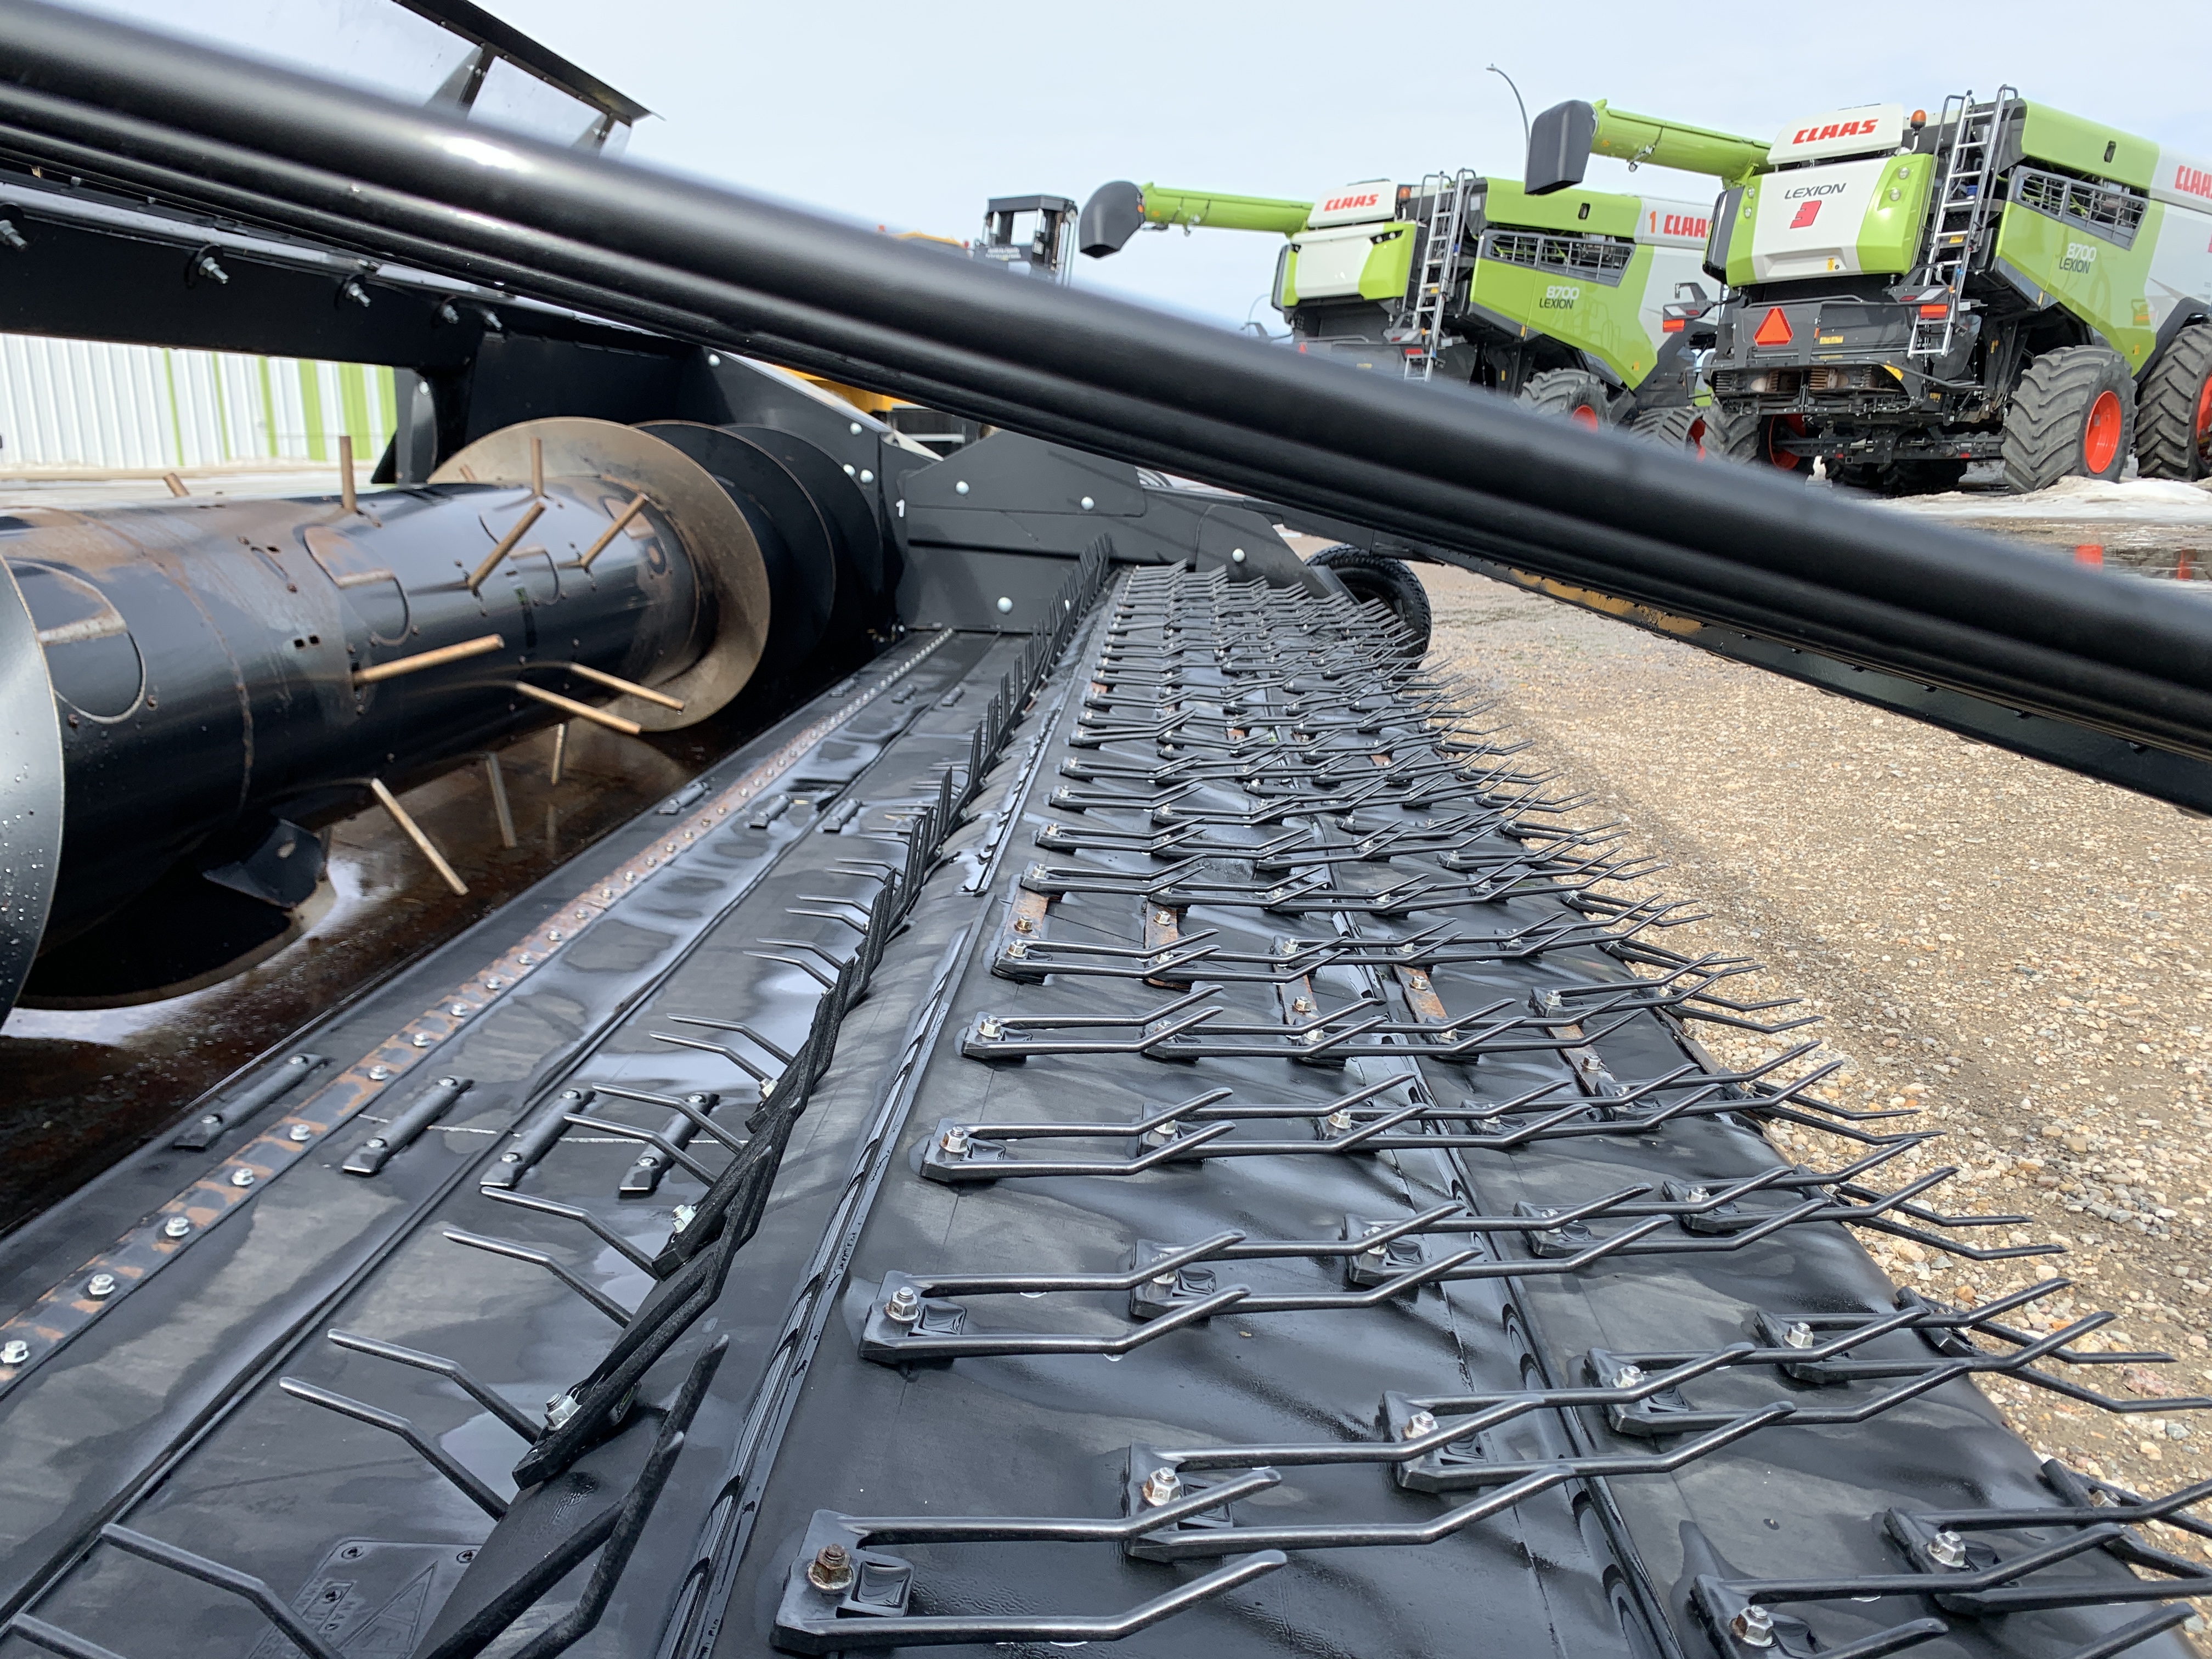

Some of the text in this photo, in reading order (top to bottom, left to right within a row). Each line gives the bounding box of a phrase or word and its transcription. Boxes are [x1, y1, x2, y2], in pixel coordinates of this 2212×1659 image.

[1792, 119, 1879, 144] CLAAS
[2175, 165, 2212, 199] CLAA
[1785, 183, 1847, 200] LEXION
[1324, 194, 1379, 212] CLAAS
[1650, 211, 1656, 234] 1
[2067, 242, 2097, 262] 8700
[2059, 256, 2091, 274] LEXION
[1546, 285, 1579, 300] 8700
[1539, 298, 1573, 309] LEXION
[896, 499, 905, 517] 1
